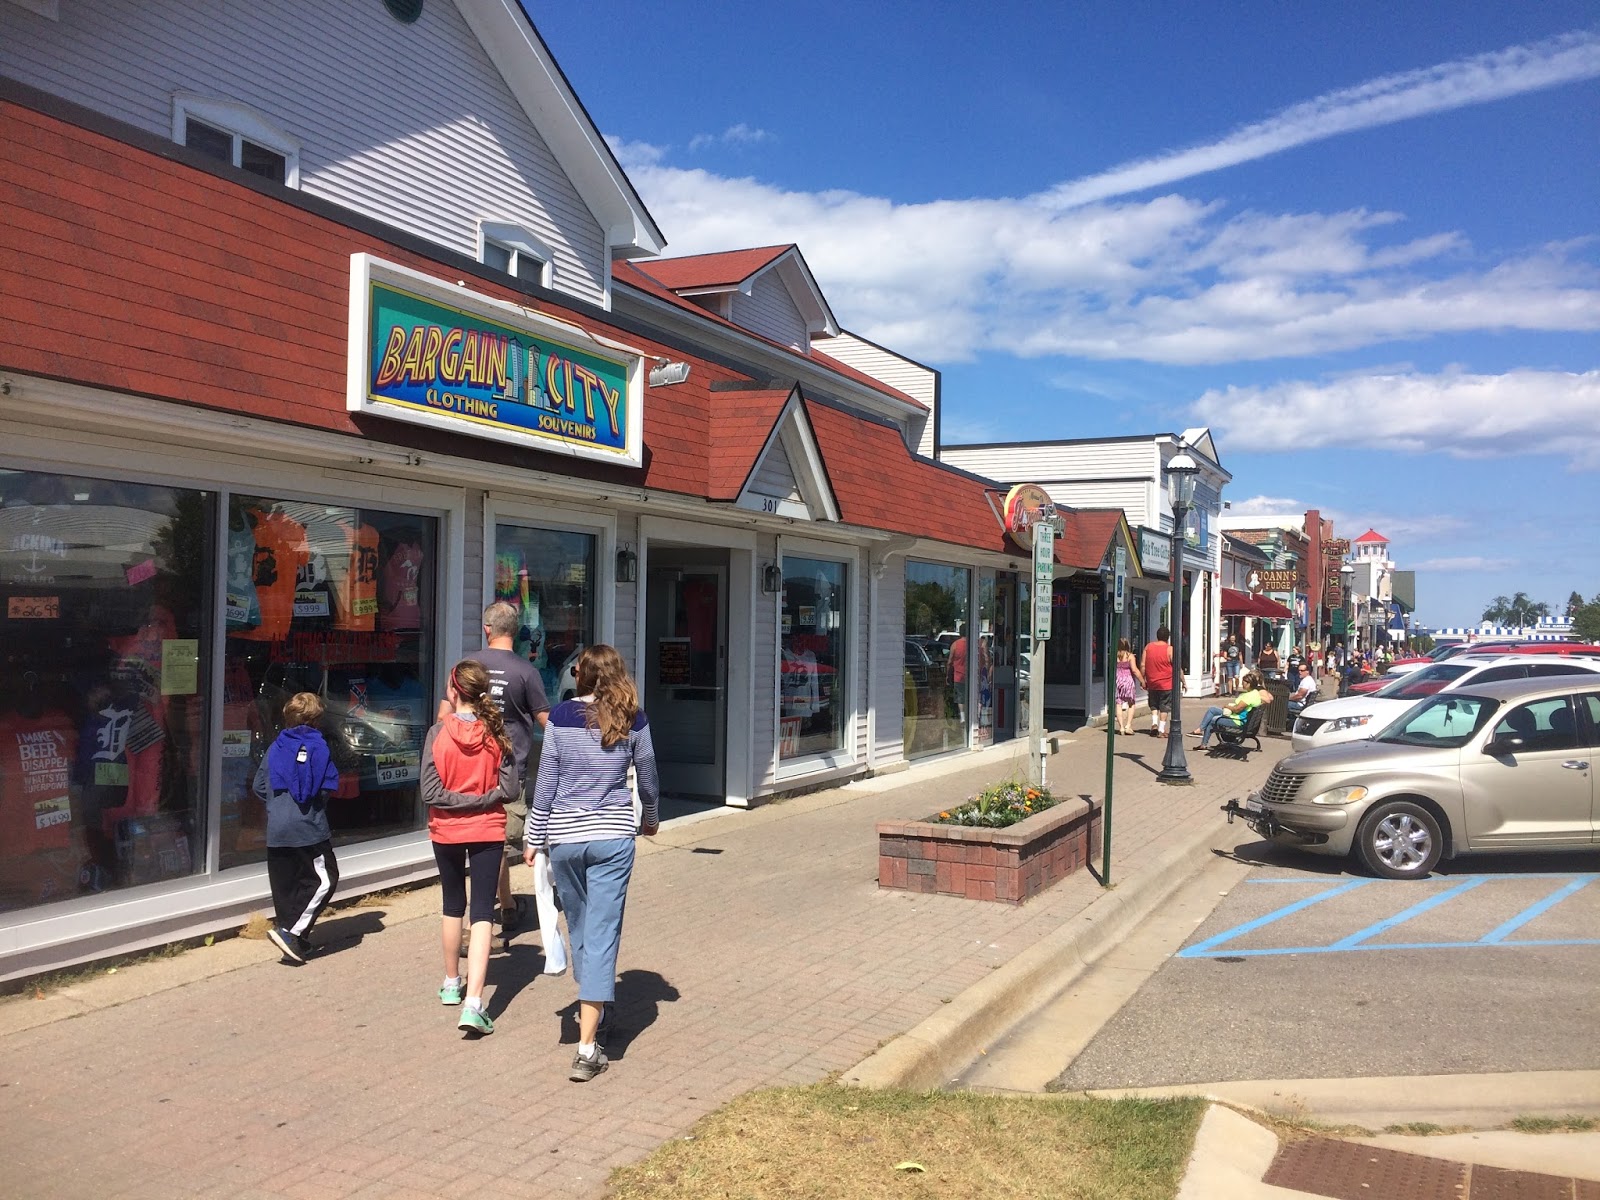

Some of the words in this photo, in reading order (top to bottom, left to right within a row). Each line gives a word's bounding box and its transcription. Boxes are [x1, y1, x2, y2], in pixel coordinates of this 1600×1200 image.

[375, 325, 508, 389] BARGAIN
[546, 352, 620, 435] CITY
[426, 388, 498, 418] CLOTHING
[538, 413, 597, 440] SOUVENIRS
[762, 497, 777, 514] 301
[1040, 531, 1052, 543] THREE
[1040, 546, 1051, 558] HOUR
[1151, 541, 1160, 557] Tree
[1037, 562, 1053, 573] PARKING
[1258, 571, 1297, 581] JOANN'S
[1265, 581, 1291, 590] FUDGE
[16, 732, 22, 744] I
[22, 731, 53, 743] MAKE
[19, 742, 58, 760] BEER
[21, 757, 68, 772] DISAPPEA
[24, 773, 54, 786] WHAT'S
[380, 769, 408, 780] 19.99
[23, 781, 69, 794] SUPERPOWE
